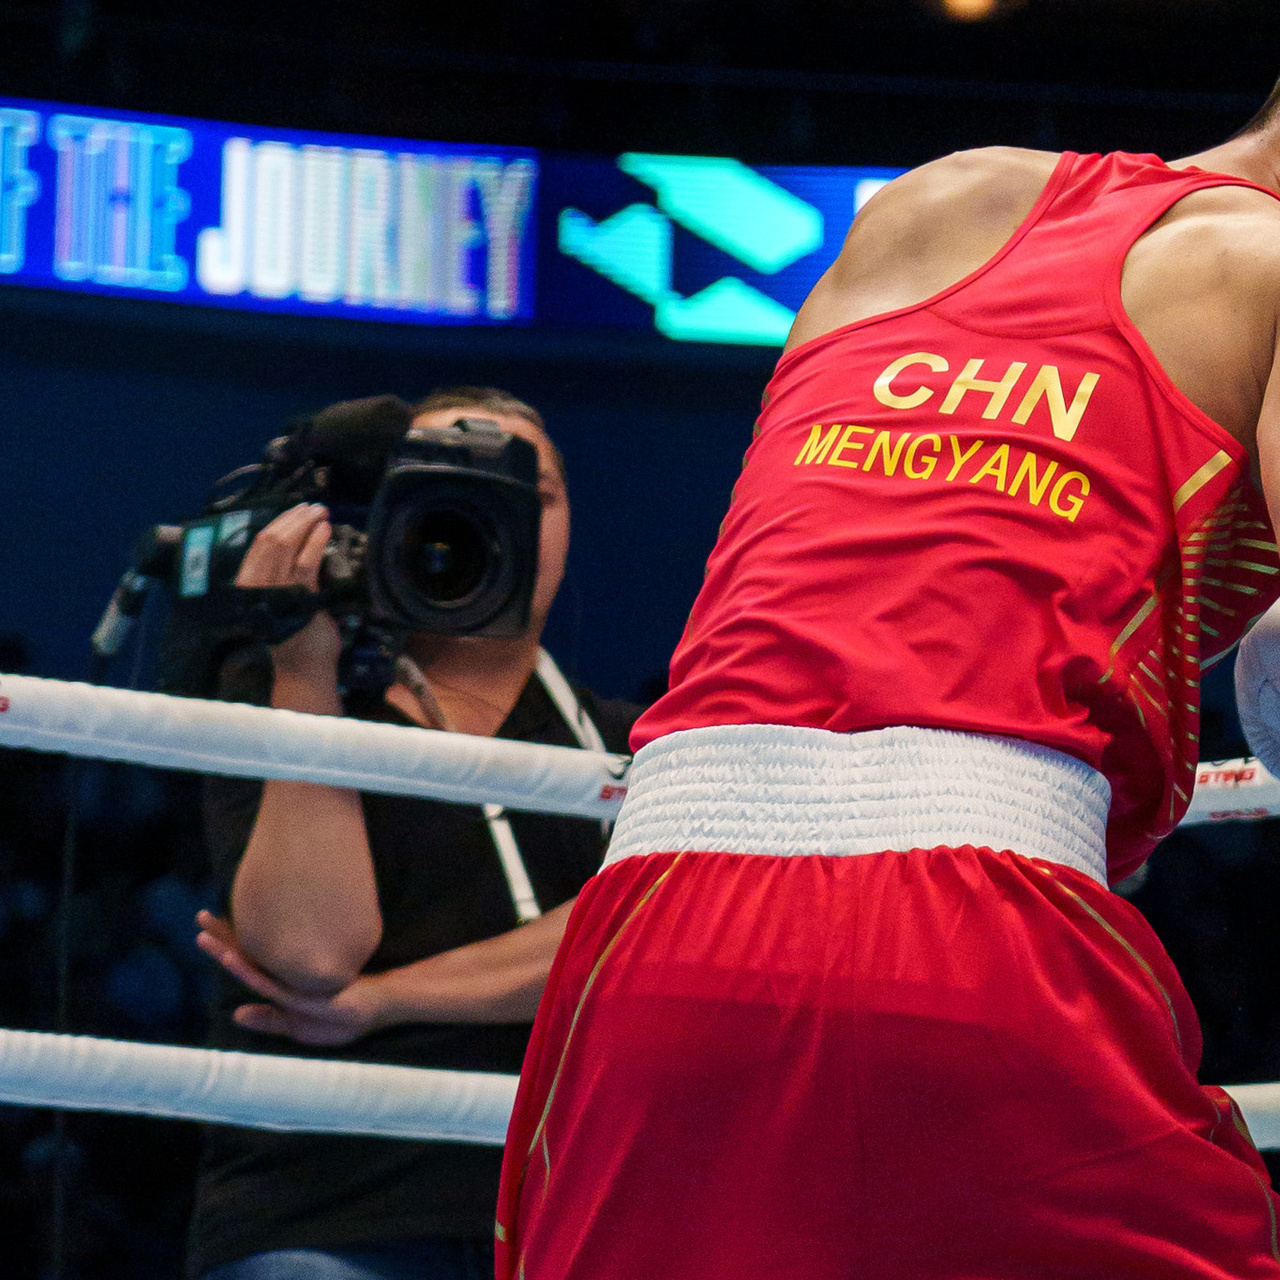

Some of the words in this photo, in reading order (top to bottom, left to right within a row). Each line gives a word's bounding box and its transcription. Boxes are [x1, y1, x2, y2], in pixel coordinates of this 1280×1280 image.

[47, 113, 193, 293] THE
[197, 136, 538, 321] JOURNEY
[873, 351, 1101, 442] CHN
[794, 424, 1091, 523] MENGYANG
